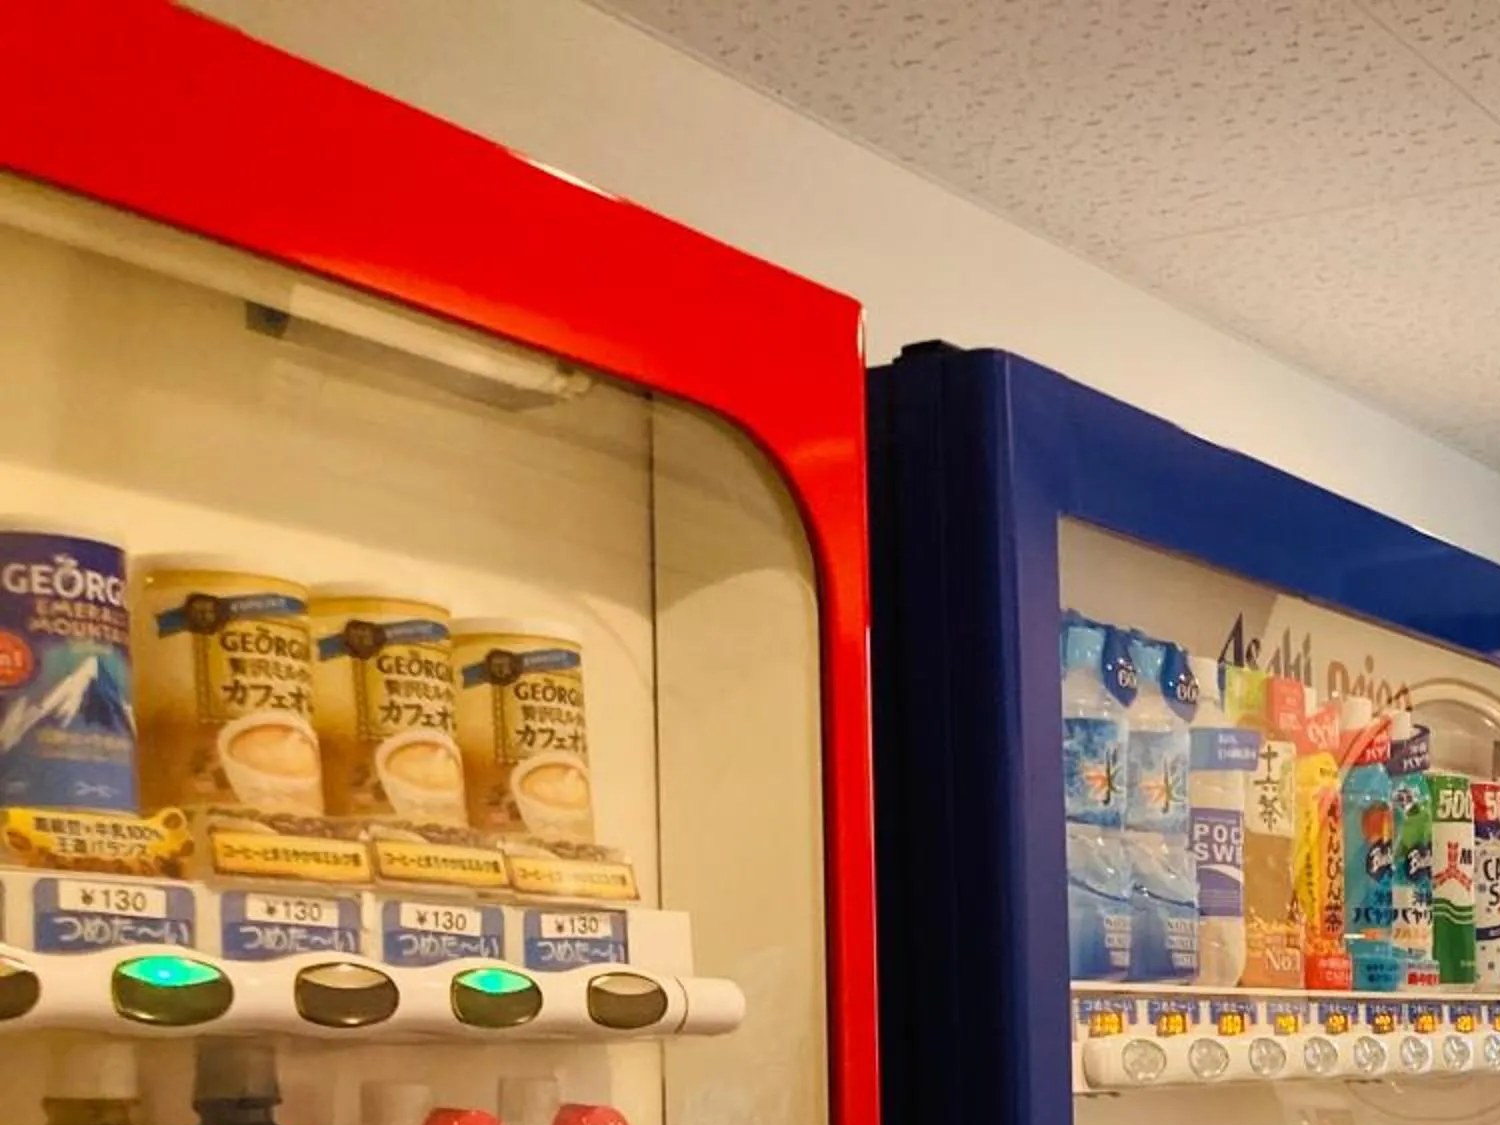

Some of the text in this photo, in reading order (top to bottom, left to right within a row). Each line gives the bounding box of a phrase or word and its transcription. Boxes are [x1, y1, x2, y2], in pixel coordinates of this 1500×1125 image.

[1253, 744, 1285, 832] 十六茶
[81, 888, 147, 912] ¥130
[266, 900, 323, 922] ¥130
[416, 908, 467, 931] ¥130
[555, 916, 600, 936] ¥130
